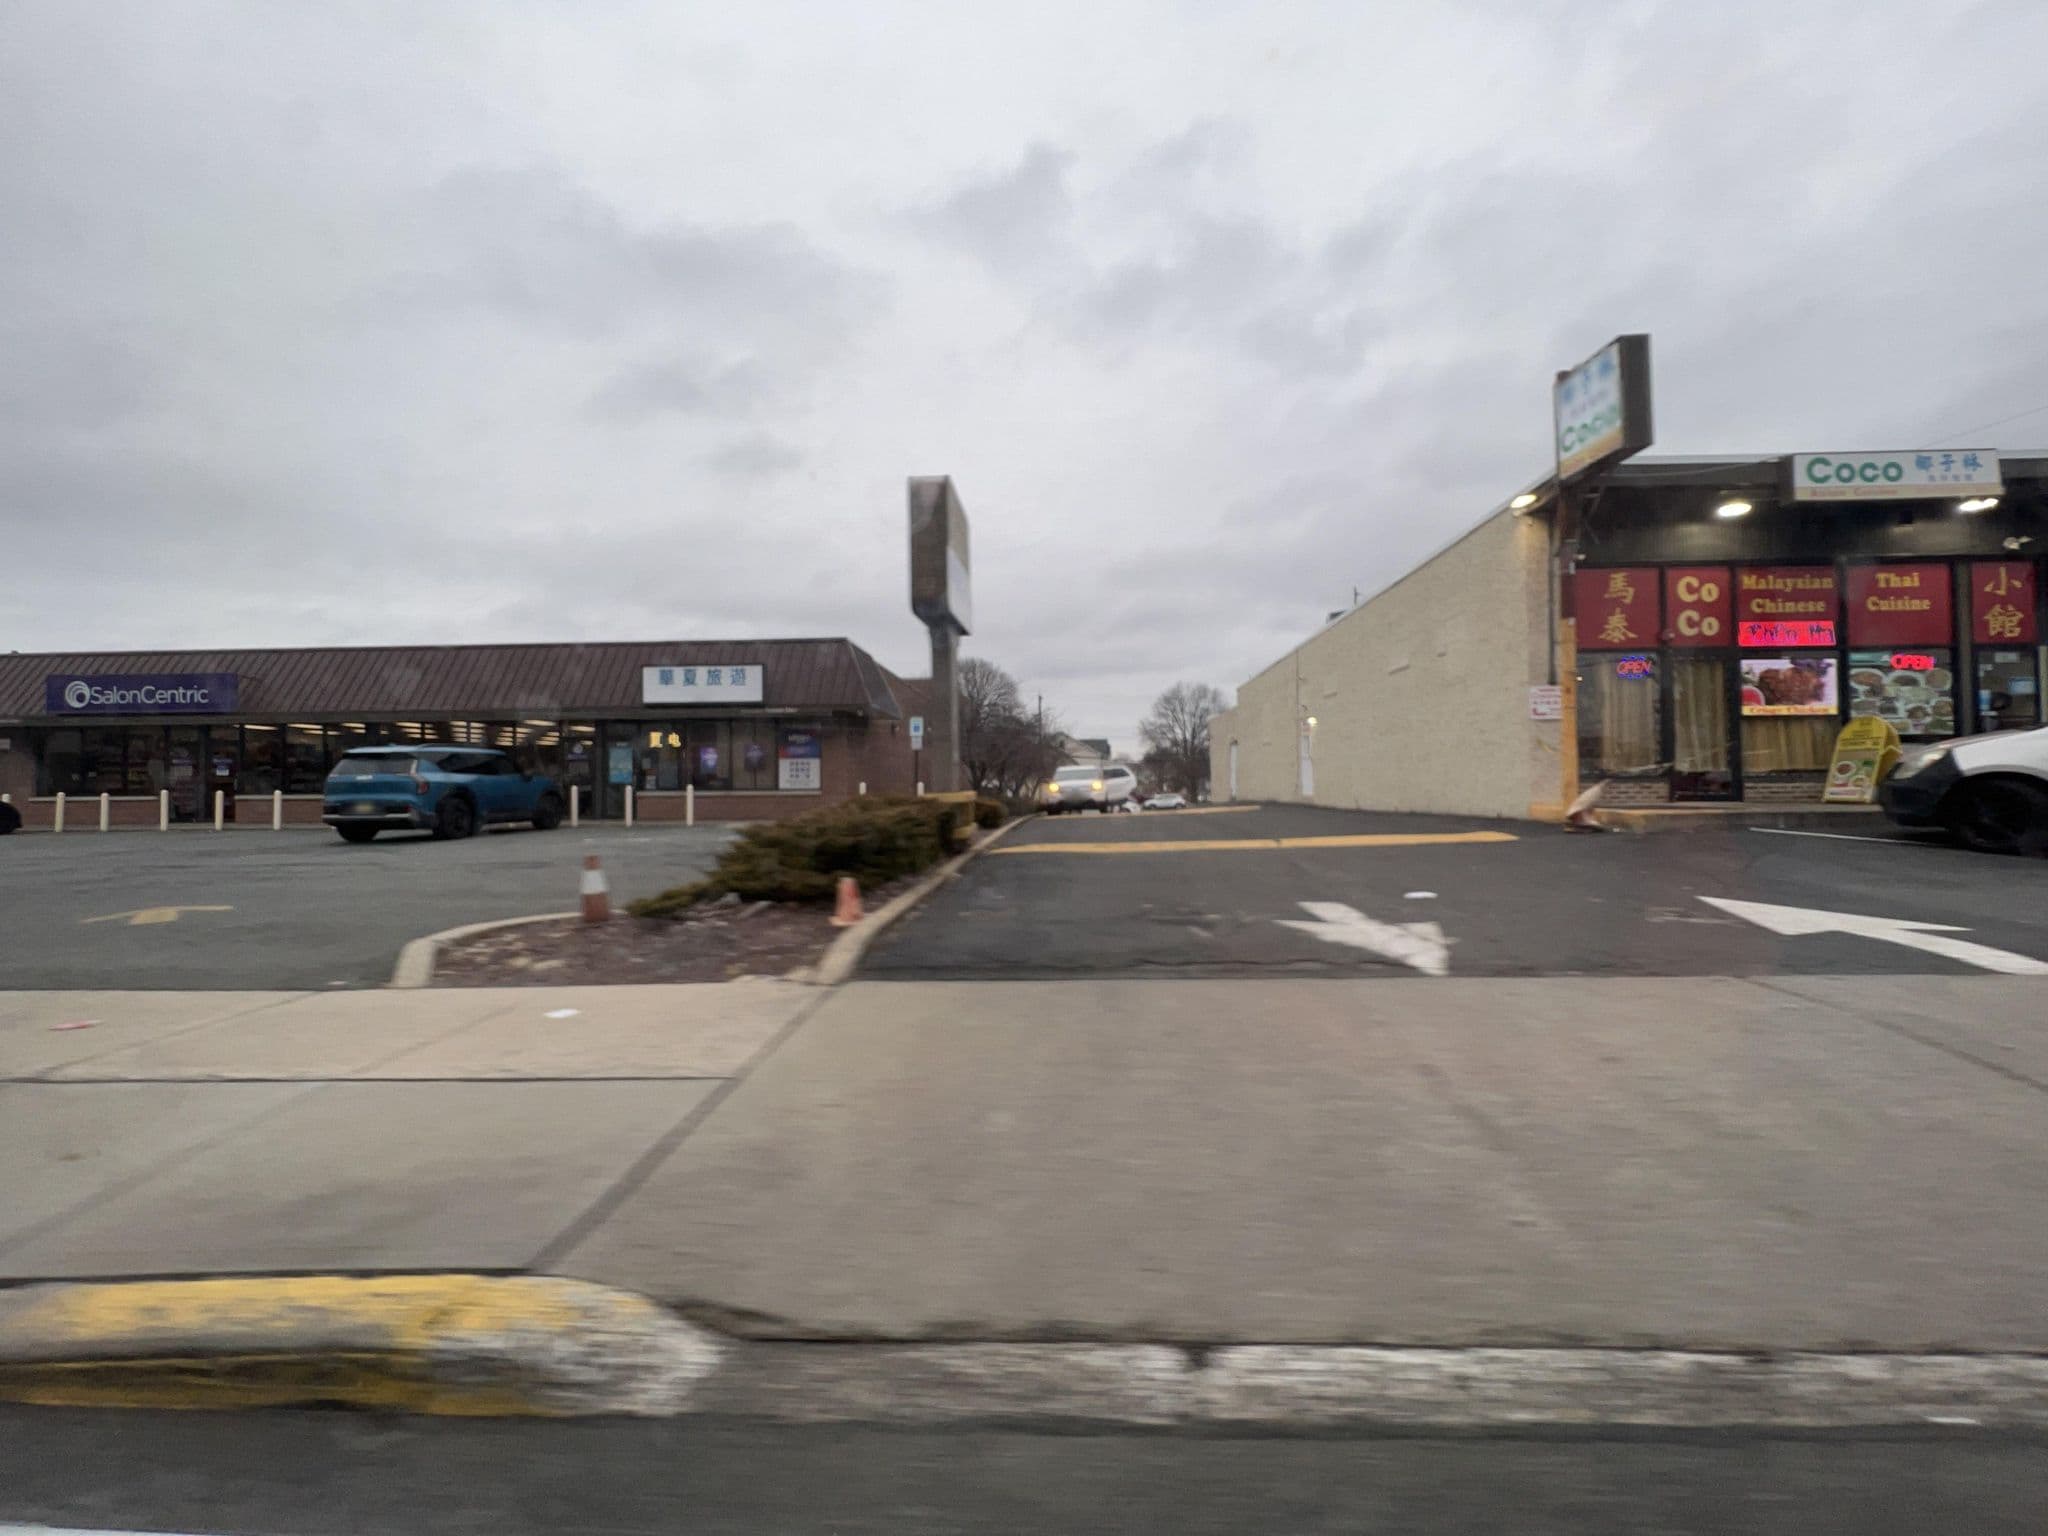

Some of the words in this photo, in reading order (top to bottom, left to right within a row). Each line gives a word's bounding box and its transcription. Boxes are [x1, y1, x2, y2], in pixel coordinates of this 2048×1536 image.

[1806, 457, 1903, 484] Coco
[1677, 576, 1720, 602] Co
[1742, 574, 1833, 592] Malaysian
[1875, 572, 1920, 588] Thai
[1751, 598, 1826, 613] Chinese
[1866, 596, 1931, 611] Cuisine
[1677, 610, 1720, 637] Co
[1616, 659, 1653, 675] OPEN
[1890, 653, 1936, 671] OPEN
[91, 685, 209, 705] SalonCentric
